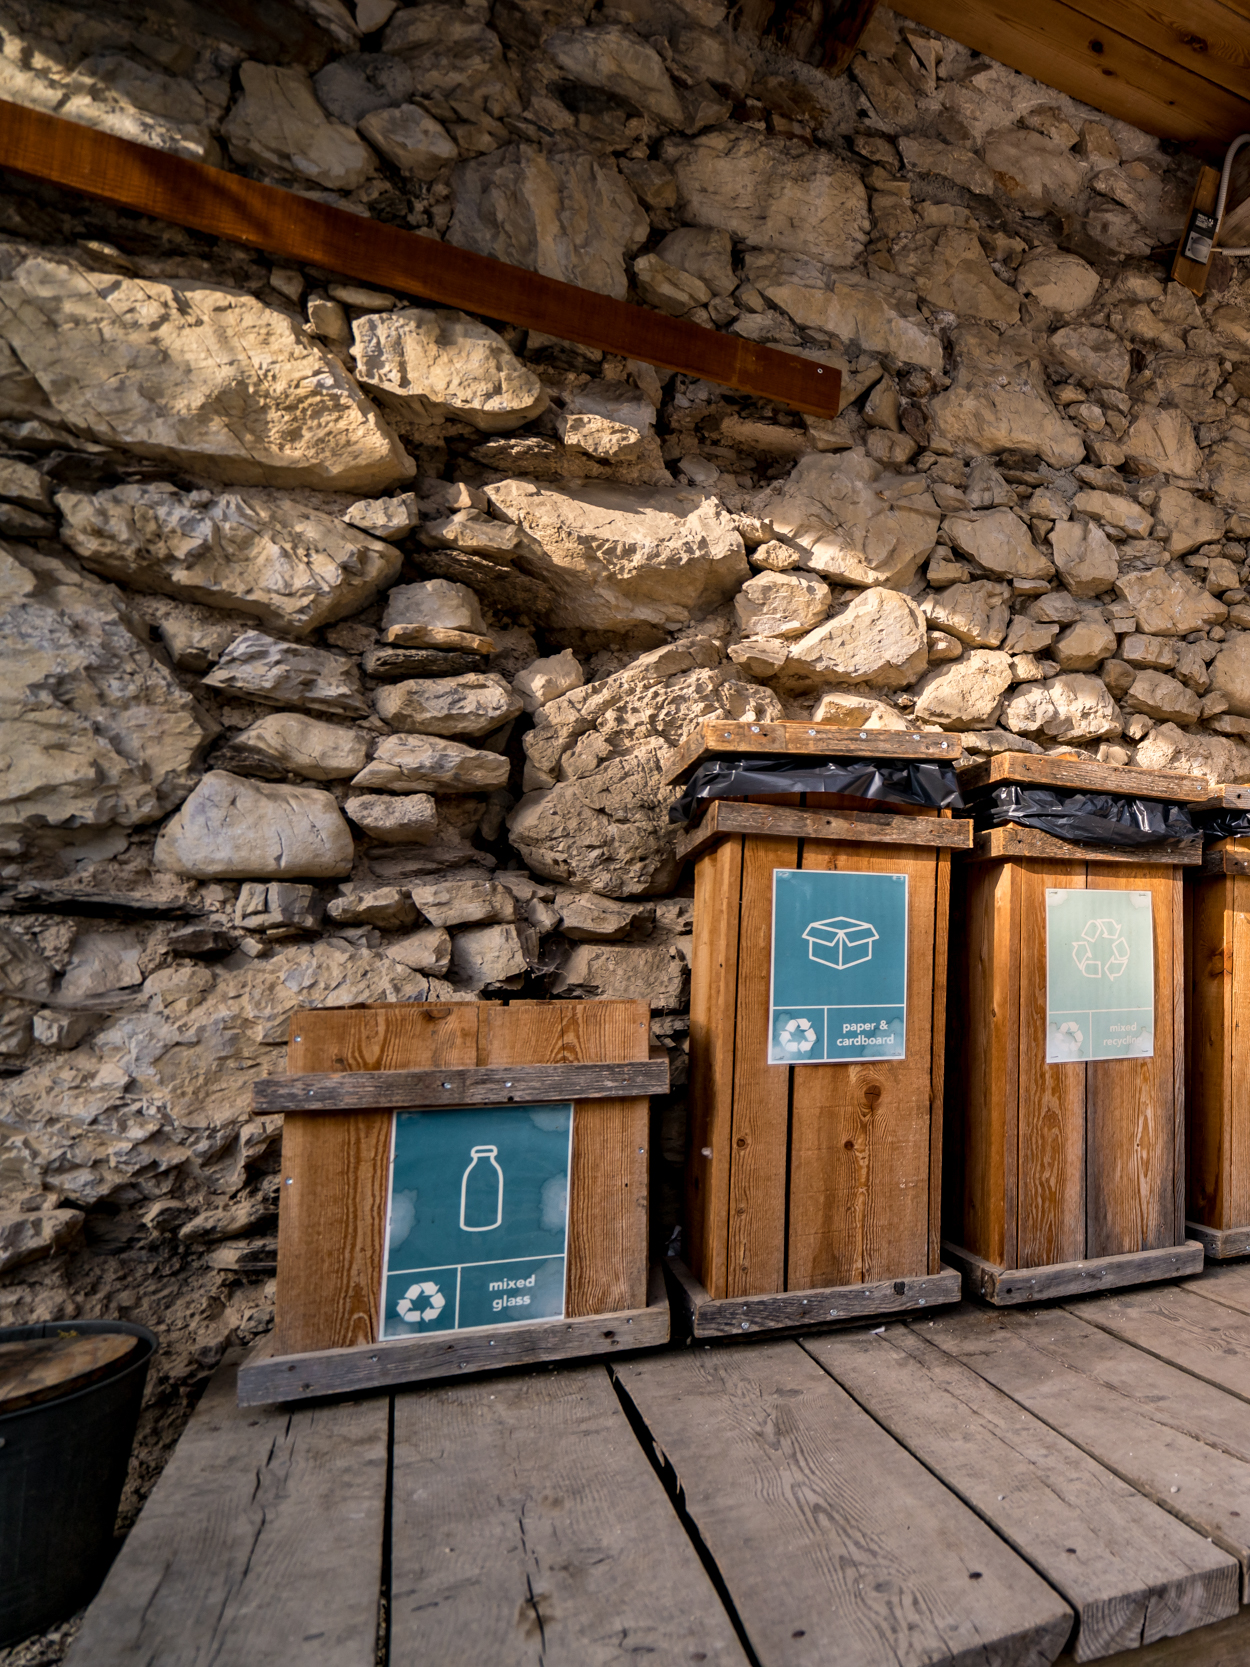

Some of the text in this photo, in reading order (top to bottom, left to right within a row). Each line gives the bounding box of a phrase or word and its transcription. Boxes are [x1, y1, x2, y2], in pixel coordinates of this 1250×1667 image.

[842, 1020, 888, 1034] paper &
[1109, 1021, 1137, 1032] mixed
[836, 1033, 894, 1046] cardboard
[489, 1274, 535, 1291] mixed
[492, 1294, 531, 1311] glass
